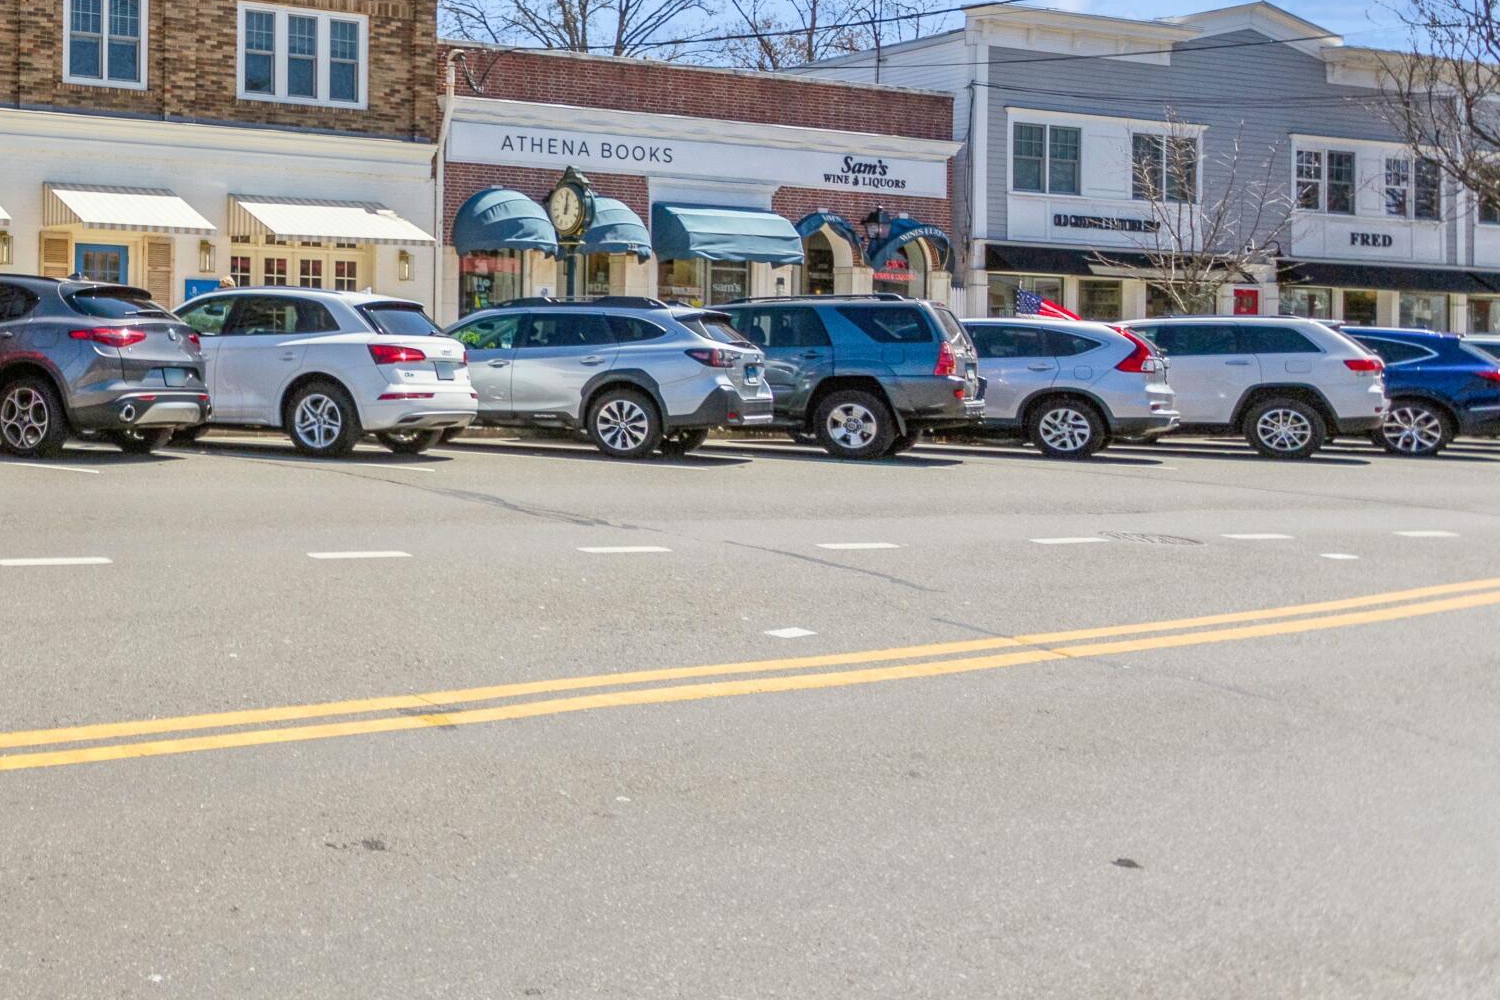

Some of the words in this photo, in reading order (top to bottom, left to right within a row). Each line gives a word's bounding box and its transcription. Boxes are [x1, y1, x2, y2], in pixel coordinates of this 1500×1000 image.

[501, 135, 590, 157] ATHENA
[601, 142, 673, 163] BOOKS
[841, 156, 889, 176] Sam's
[823, 174, 850, 184] WINE
[862, 177, 906, 189] LIQUORS
[1350, 232, 1393, 248] FRED
